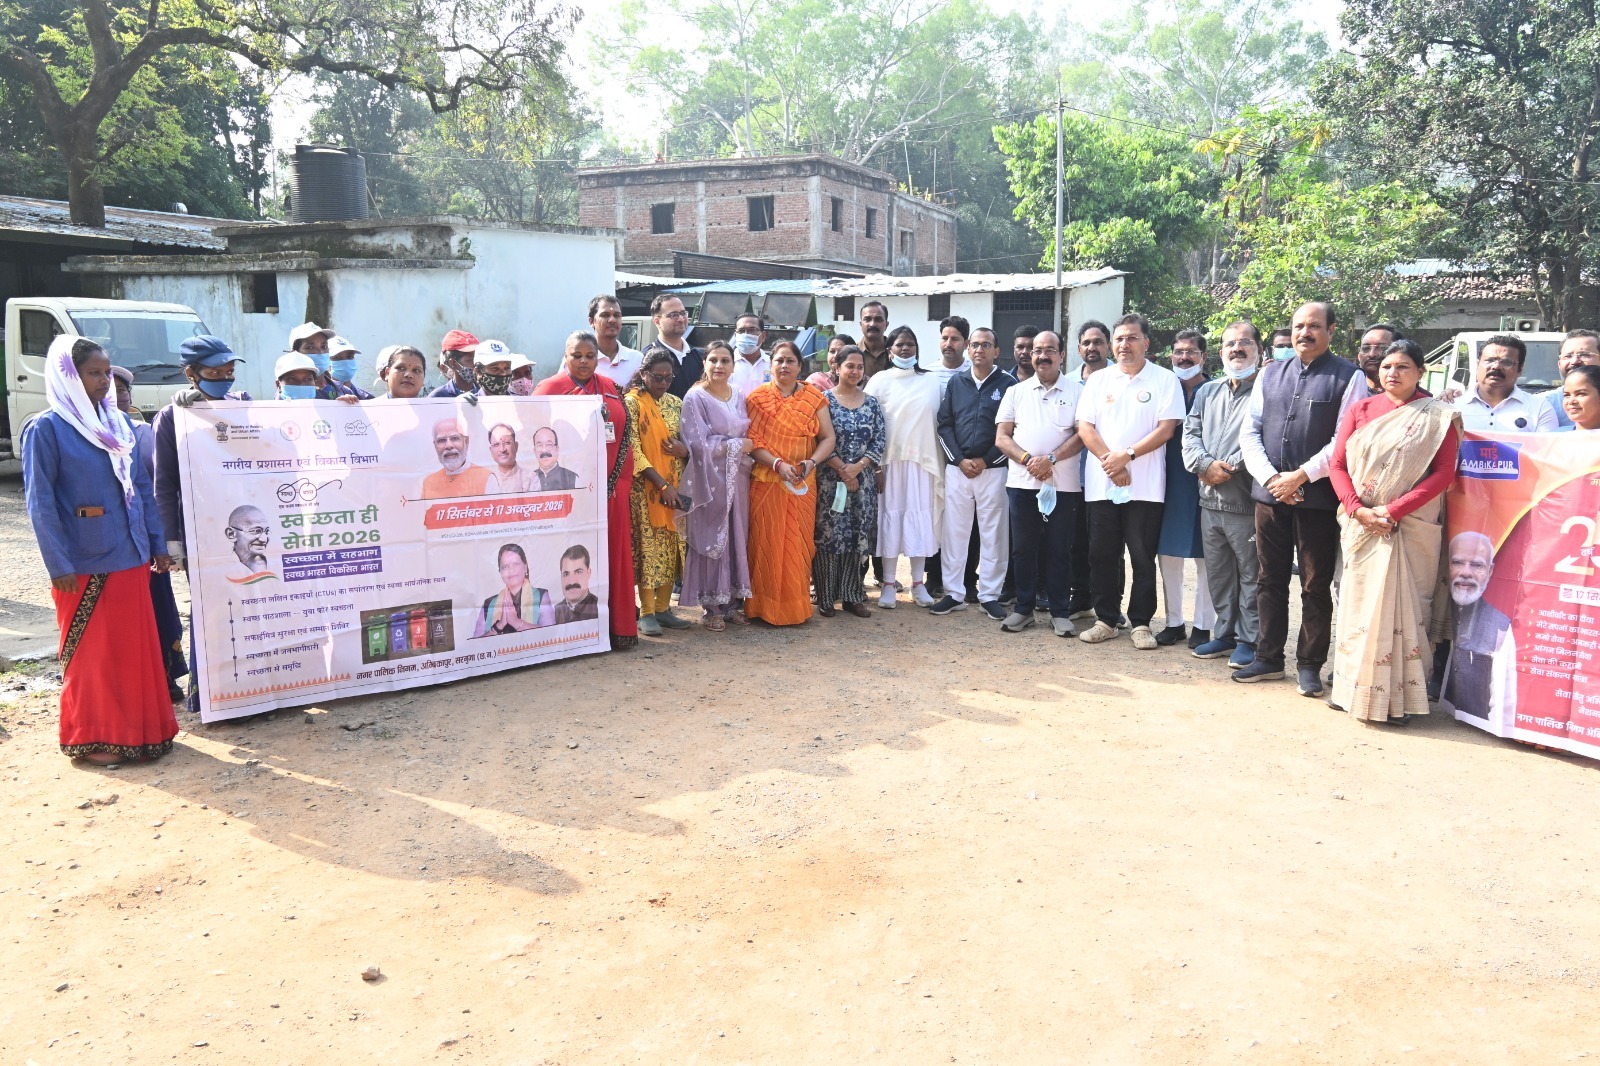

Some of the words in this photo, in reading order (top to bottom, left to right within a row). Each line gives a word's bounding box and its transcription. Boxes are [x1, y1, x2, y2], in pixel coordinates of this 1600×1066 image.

[1480, 442, 1498, 462] माई
[222, 458, 252, 470] नगरीय
[256, 459, 292, 469] प्रशासन
[297, 456, 310, 468] एवं
[315, 455, 346, 466] विकास
[350, 452, 378, 464] विभाग
[279, 510, 355, 528] स्वच्छता
[359, 504, 379, 524] ही
[436, 509, 445, 520] 17
[447, 506, 483, 520] सितंबर
[484, 504, 494, 517] से
[496, 505, 504, 516] 17
[505, 503, 543, 518] अक्टूबर
[544, 501, 563, 512] 2026
[281, 532, 323, 550] सेवा
[329, 530, 380, 546] 2026
[1554, 515, 1600, 577] 2
[284, 554, 322, 564] स्वच्छता
[326, 551, 336, 560] में
[340, 549, 378, 559] सहभाग
[285, 570, 305, 579] स्वच्छ
[307, 568, 327, 576] भारत
[329, 564, 358, 575] विकसित
[361, 563, 379, 571] भारत
[315, 590, 337, 598] (CTUs)
[1576, 590, 1584, 599] 17
[1587, 590, 1600, 600] सि
[262, 611, 291, 620] पाठशाला
[302, 609, 314, 618] युवा
[244, 630, 275, 641] सफाईमित्र
[277, 630, 295, 639] सुरक्षा
[297, 626, 307, 636] एवं
[246, 652, 271, 660] स्वच्छता
[280, 642, 319, 655] जनभागीदारी
[247, 667, 272, 676] स्वच्छता
[274, 664, 280, 672] से
[282, 661, 301, 672] समृद्धि
[356, 671, 372, 680] नगर
[374, 667, 395, 677] पालिक
[1555, 688, 1571, 699] सेवा
[1517, 713, 1534, 724] नगर
[1535, 717, 1564, 729] पालिक
